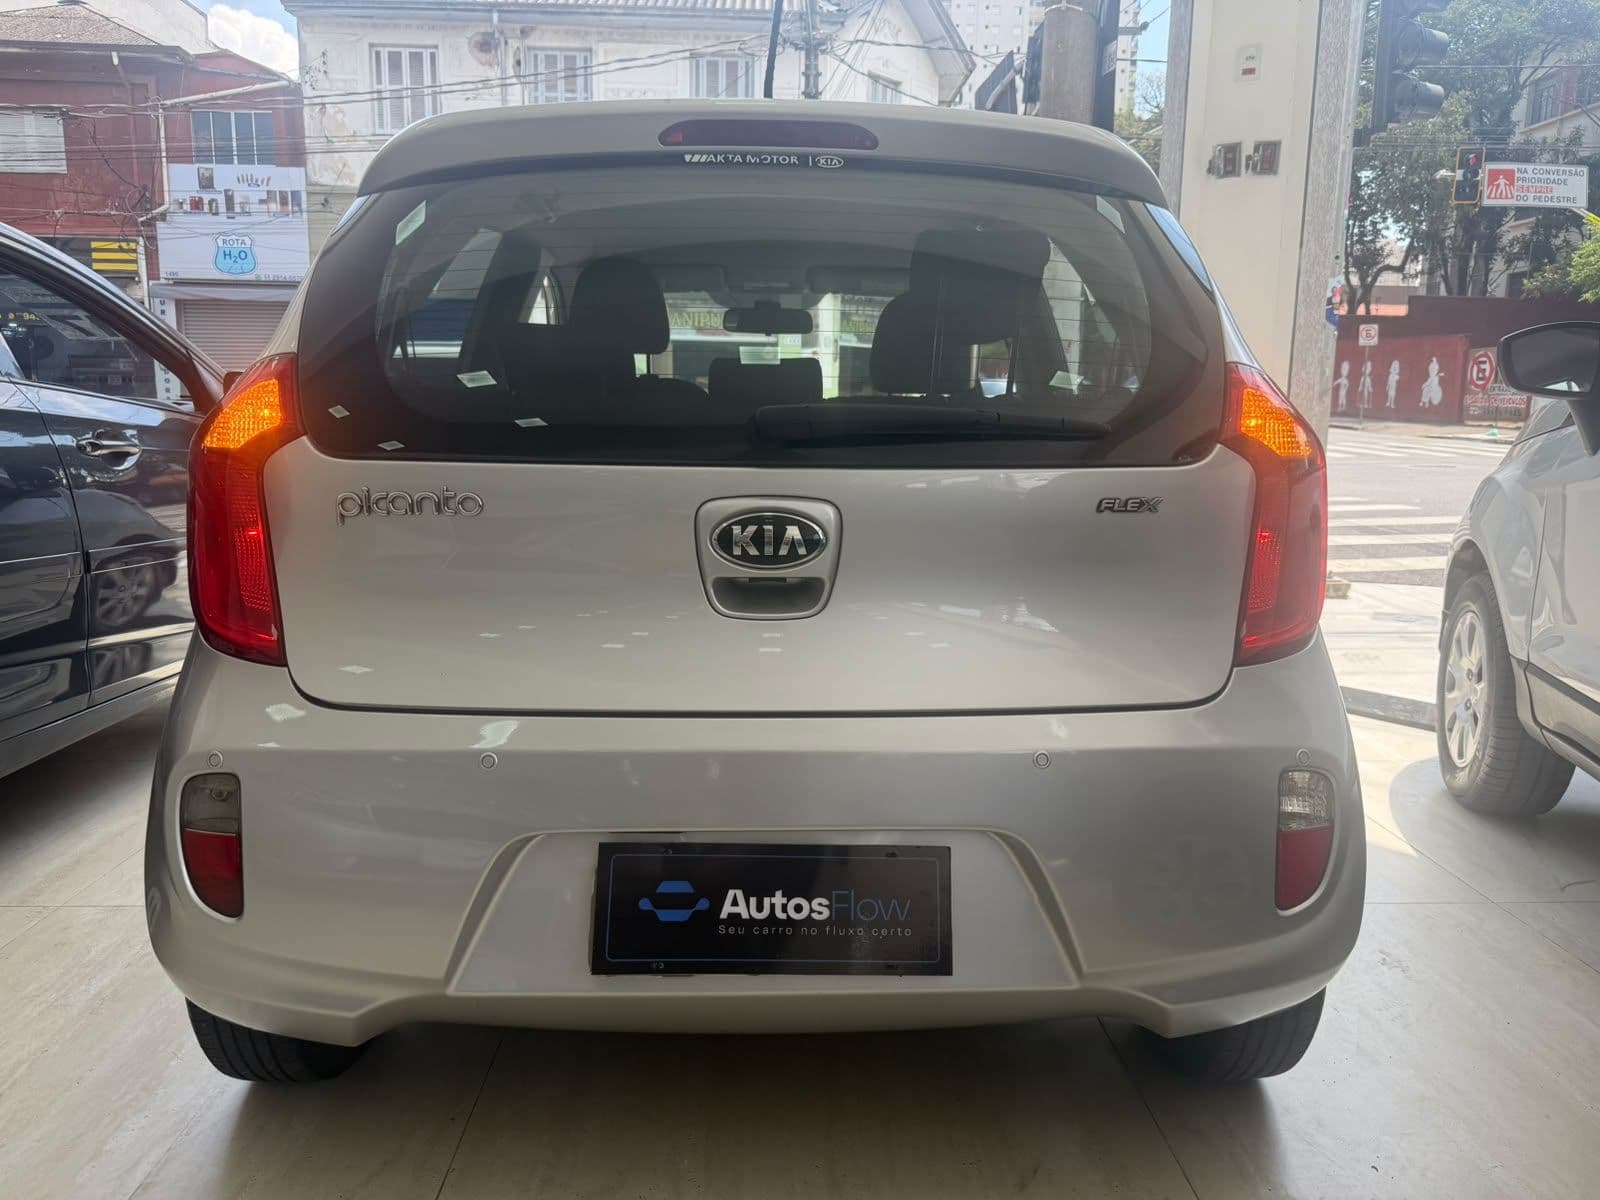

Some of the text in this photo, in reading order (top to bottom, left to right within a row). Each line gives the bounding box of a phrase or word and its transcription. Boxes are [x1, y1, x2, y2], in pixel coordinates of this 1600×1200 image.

[746, 155, 799, 165] MOTOR
[1516, 167, 1585, 177] NA CONVERSÃO
[1516, 176, 1568, 186] PRIORIDADE
[1516, 185, 1553, 194] SEMPRE
[1516, 194, 1577, 204] DO PEDESTRE
[222, 238, 247, 246] ROTA
[336, 486, 484, 526] picanto
[1096, 497, 1164, 513] FLEX
[731, 525, 808, 556] KIA
[718, 924, 912, 936] Seu carro no fluxo certo
